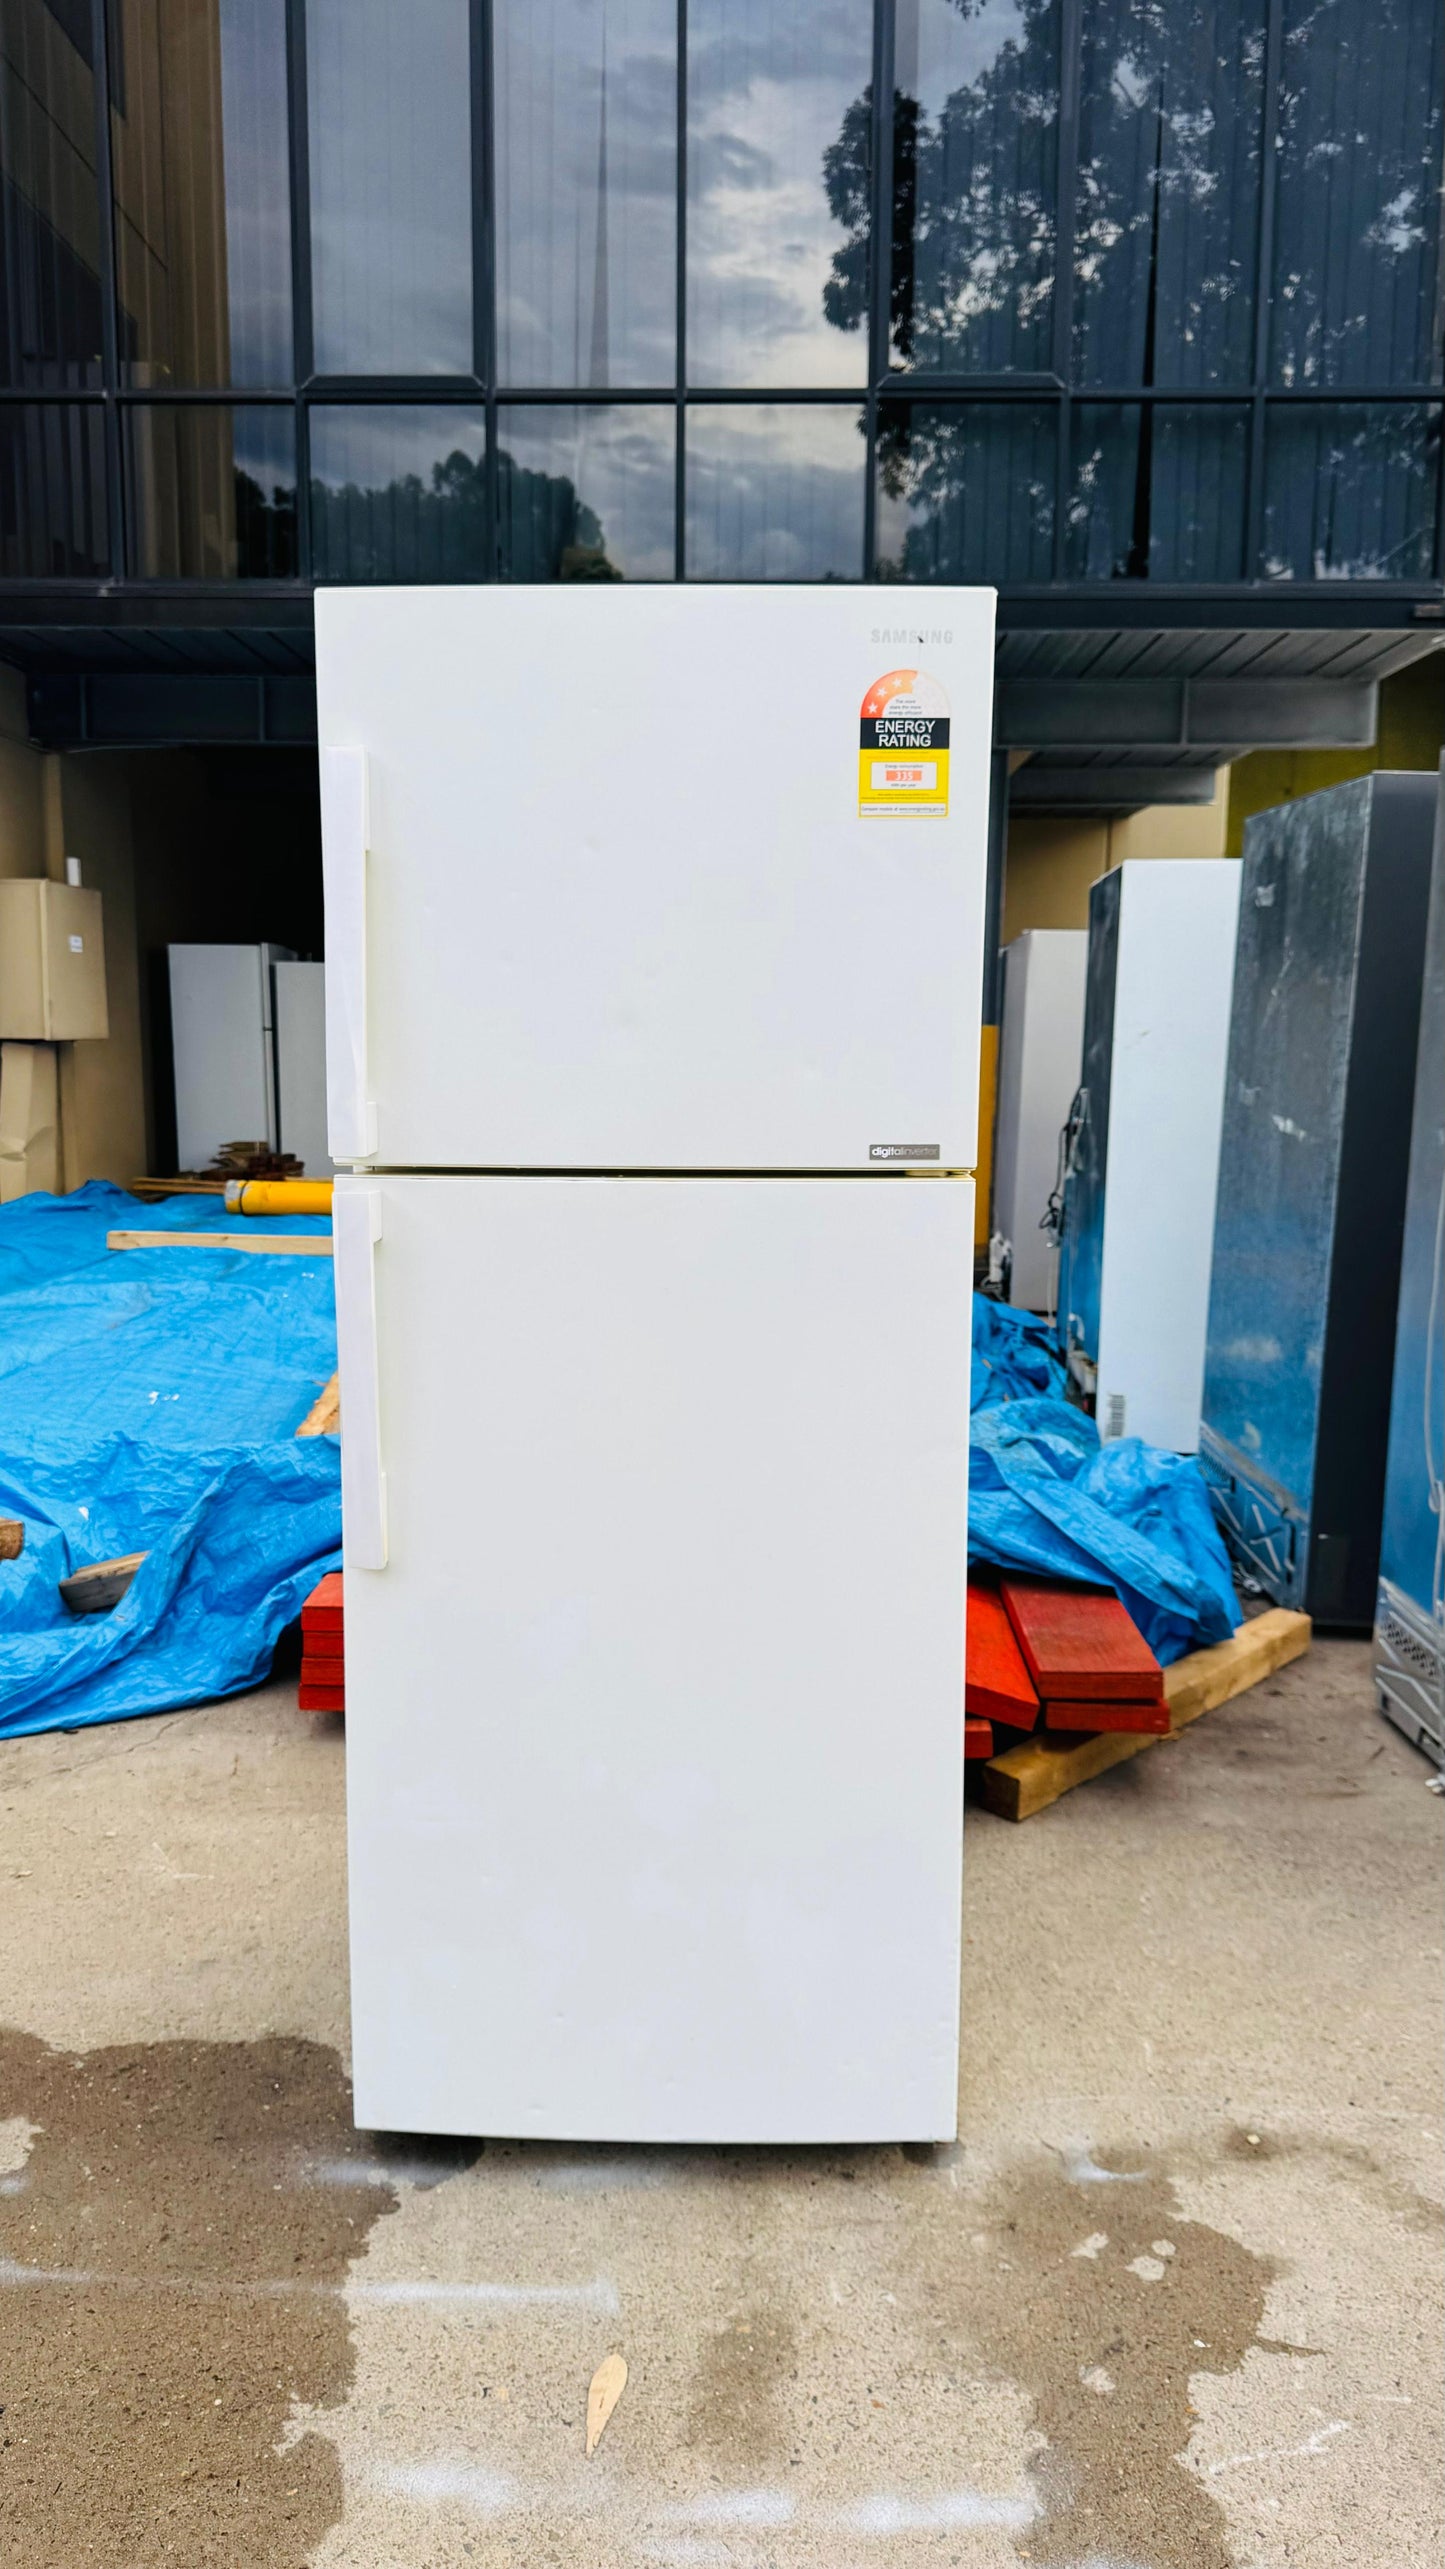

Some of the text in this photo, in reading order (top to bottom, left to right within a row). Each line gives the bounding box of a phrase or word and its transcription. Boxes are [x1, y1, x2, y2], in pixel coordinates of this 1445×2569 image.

[871, 628, 953, 644] SAMSUNG
[875, 720, 936, 734] ENERGY
[878, 733, 932, 748] RATING
[895, 769, 913, 782] 335
